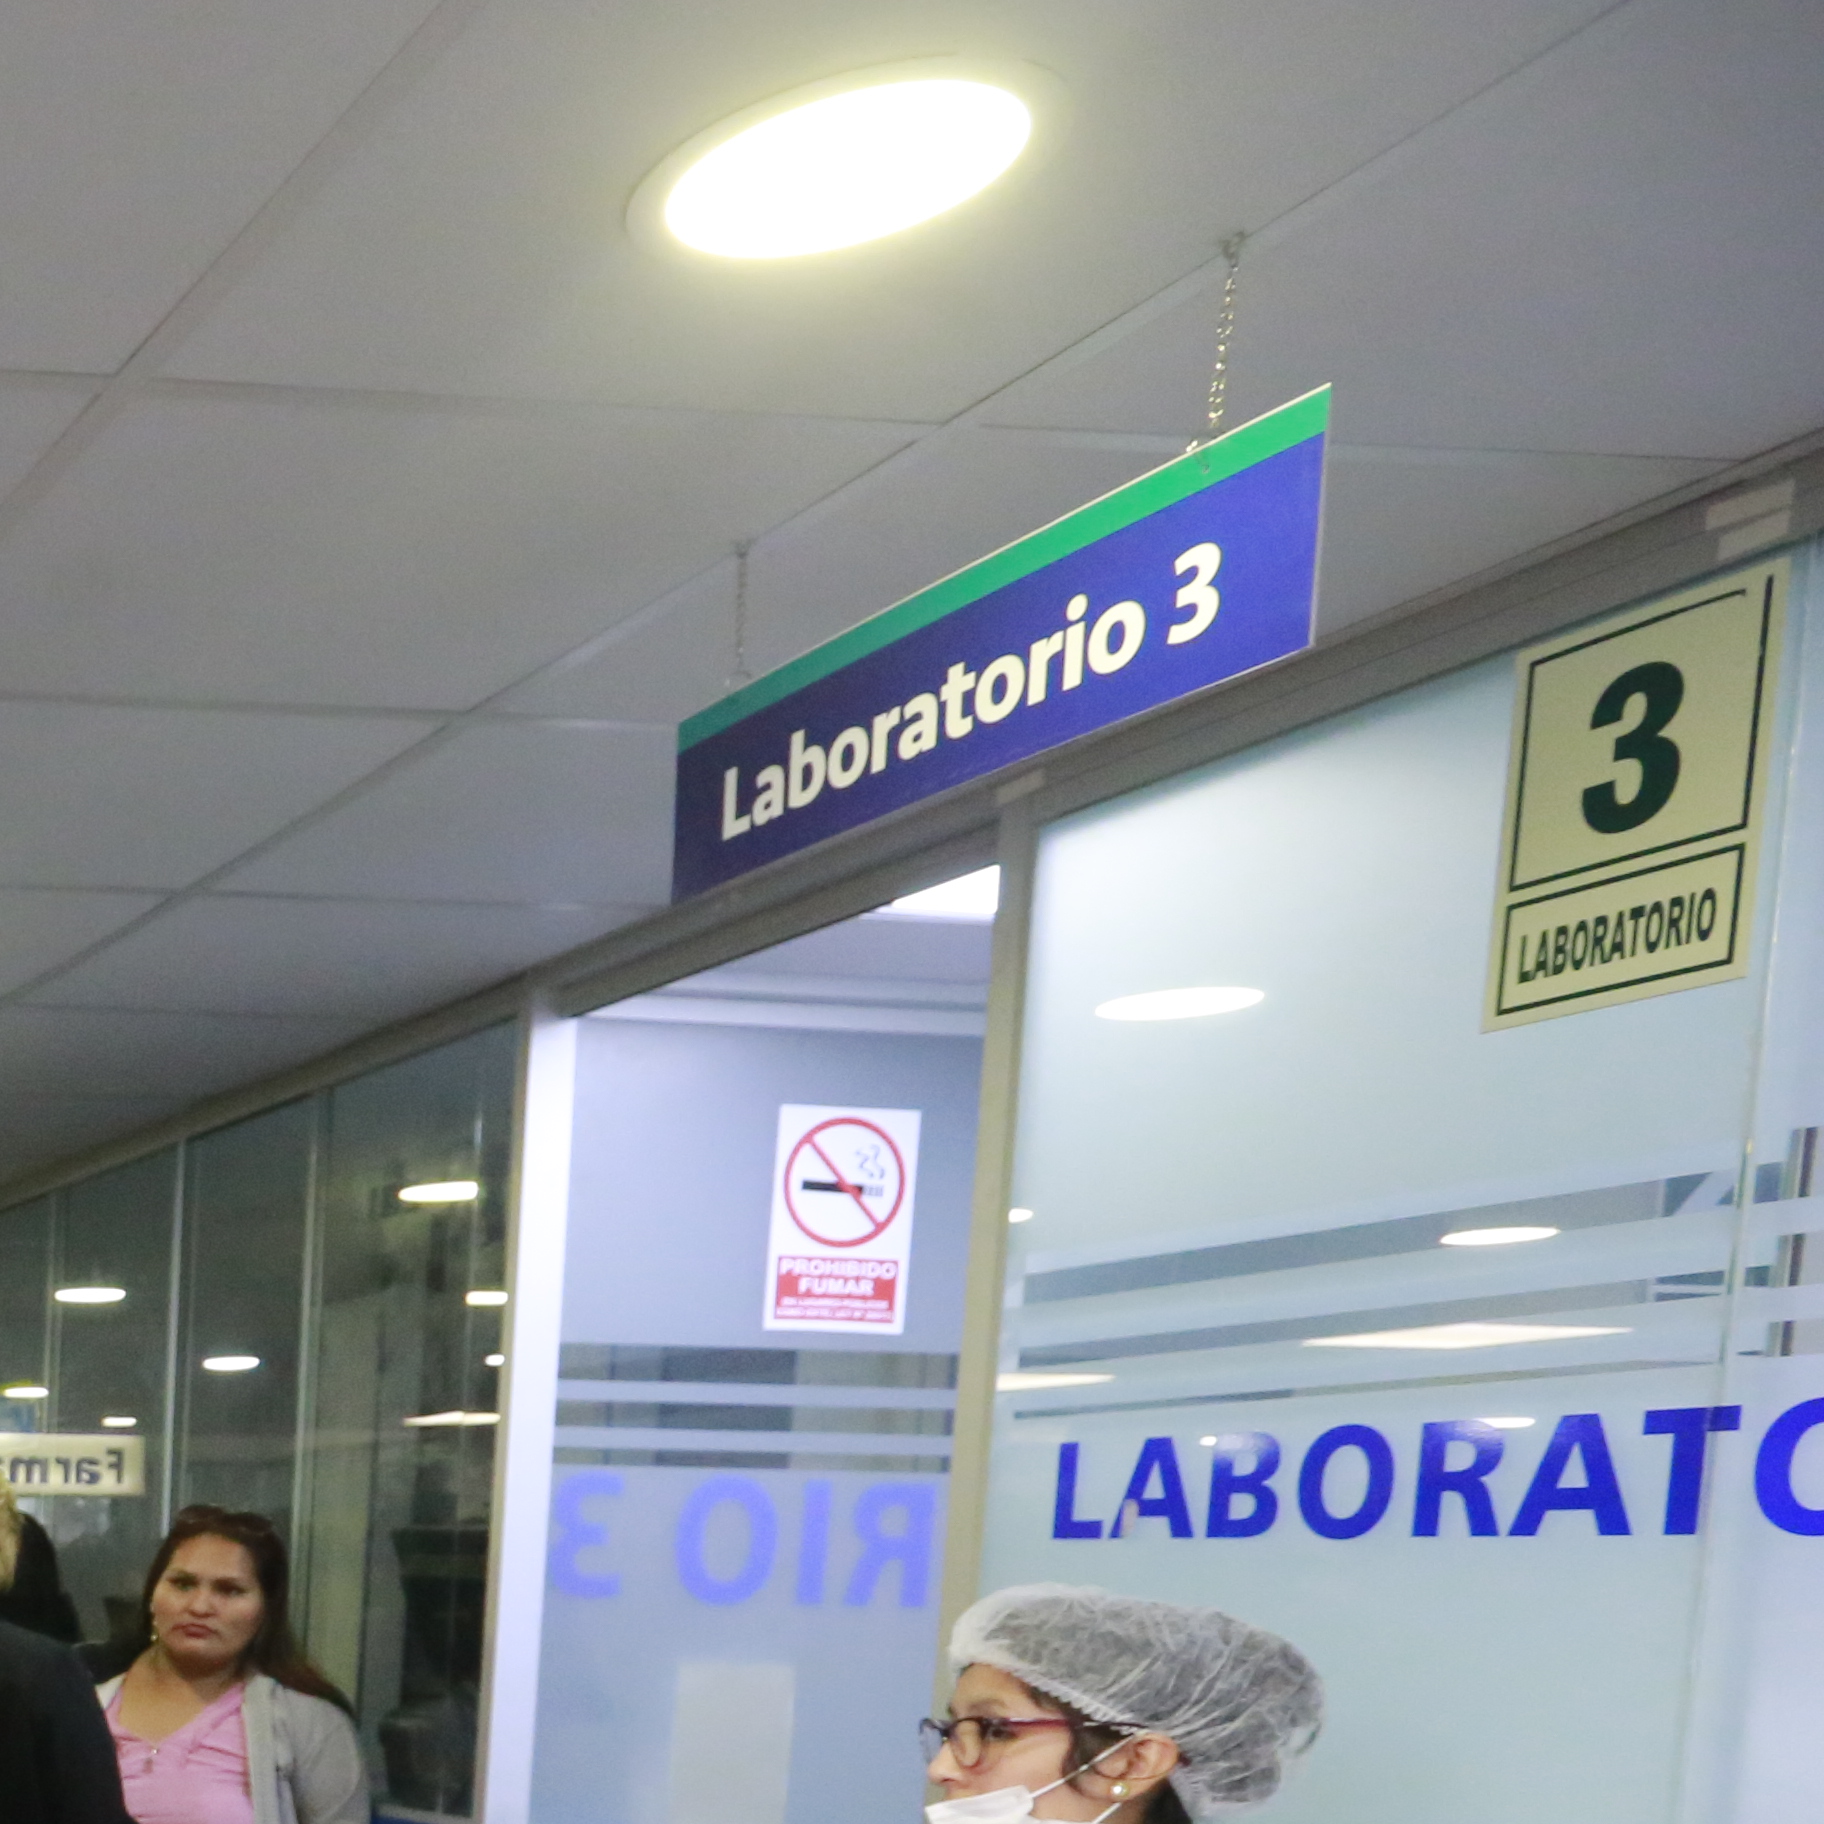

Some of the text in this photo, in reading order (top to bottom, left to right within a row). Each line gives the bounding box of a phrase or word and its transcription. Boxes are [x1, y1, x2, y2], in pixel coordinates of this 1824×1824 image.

[721, 542, 1222, 842] Laboratorio 3
[1581, 661, 1685, 834] 3
[1517, 887, 1717, 985] LABORATORIO
[779, 1258, 897, 1280] PROHIBIDO
[798, 1277, 875, 1297] FUMAR
[1052, 1397, 1824, 1541] LABORATO
